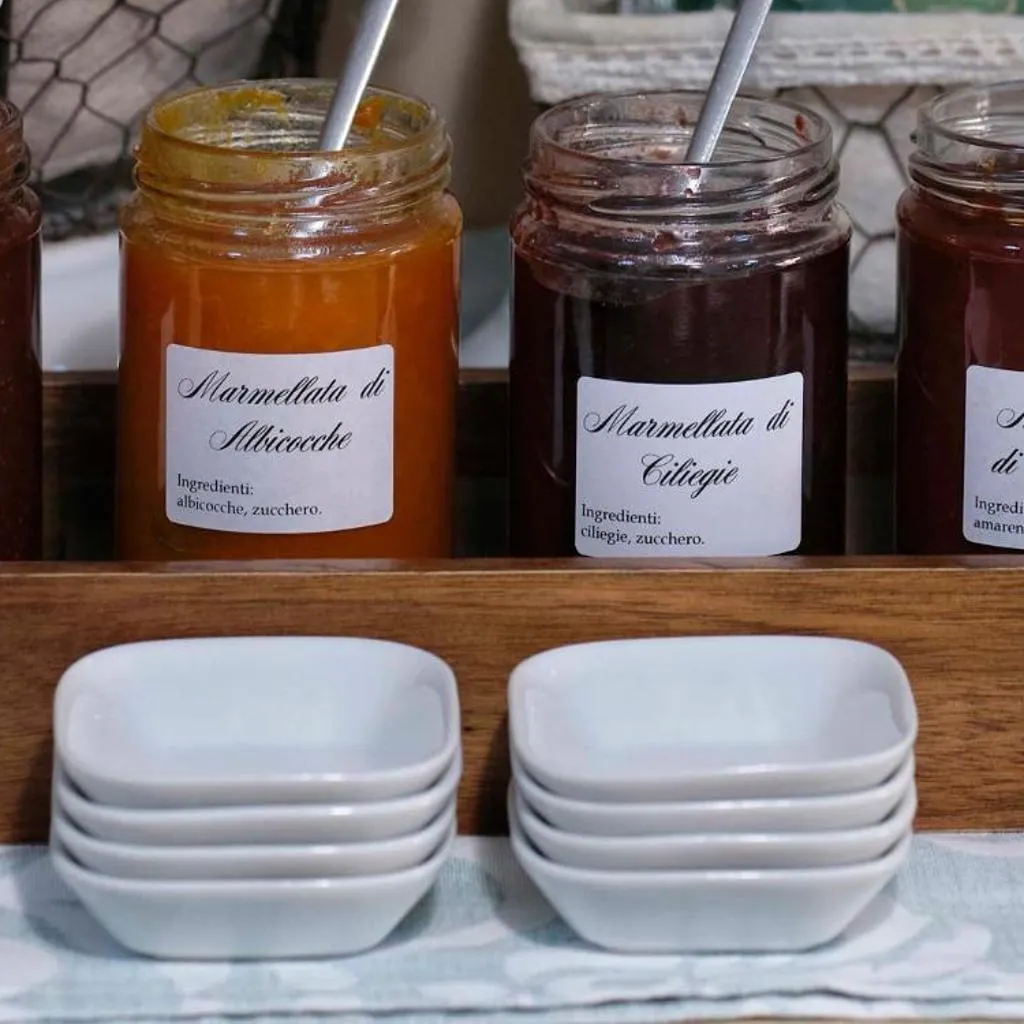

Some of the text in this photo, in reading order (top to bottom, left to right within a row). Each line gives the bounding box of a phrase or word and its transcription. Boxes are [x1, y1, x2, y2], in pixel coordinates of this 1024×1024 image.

[177, 367, 390, 406] Marmellata di
[583, 399, 794, 439] Marmellata di
[209, 420, 352, 453] Albicocche
[991, 448, 1023, 475] di
[177, 474, 254, 495] Ingredienti:
[641, 454, 739, 499] Ciliegie
[177, 495, 323, 517] albicocche, zucchero.
[581, 504, 661, 525] Ingredienti:
[581, 526, 705, 546] ciliegie, zucchero.
